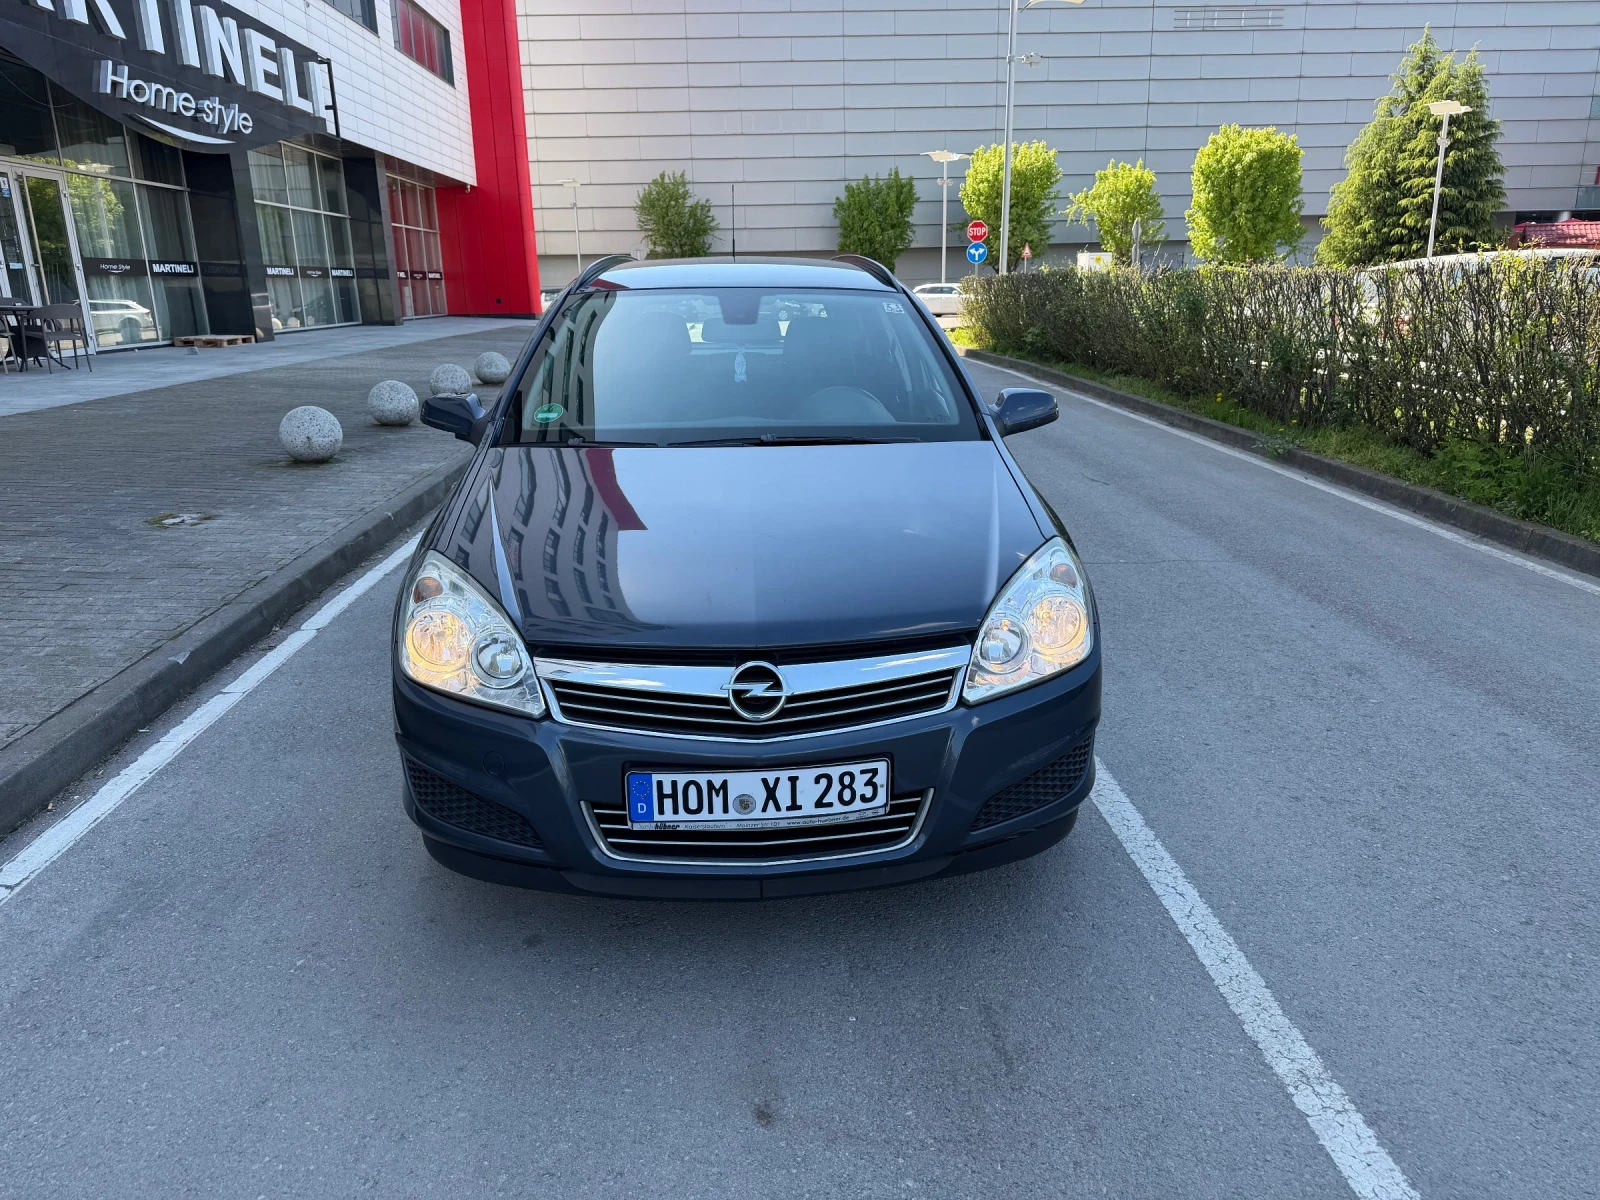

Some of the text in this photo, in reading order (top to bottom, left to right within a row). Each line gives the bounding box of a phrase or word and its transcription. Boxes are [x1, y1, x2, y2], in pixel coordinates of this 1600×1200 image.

[99, 60, 253, 134] Home style
[969, 227, 986, 236] STOP
[152, 263, 194, 273] MARTINELI
[266, 267, 294, 276] MARTINELI
[656, 767, 879, 815] HOM XI 283
[638, 803, 646, 813] D
